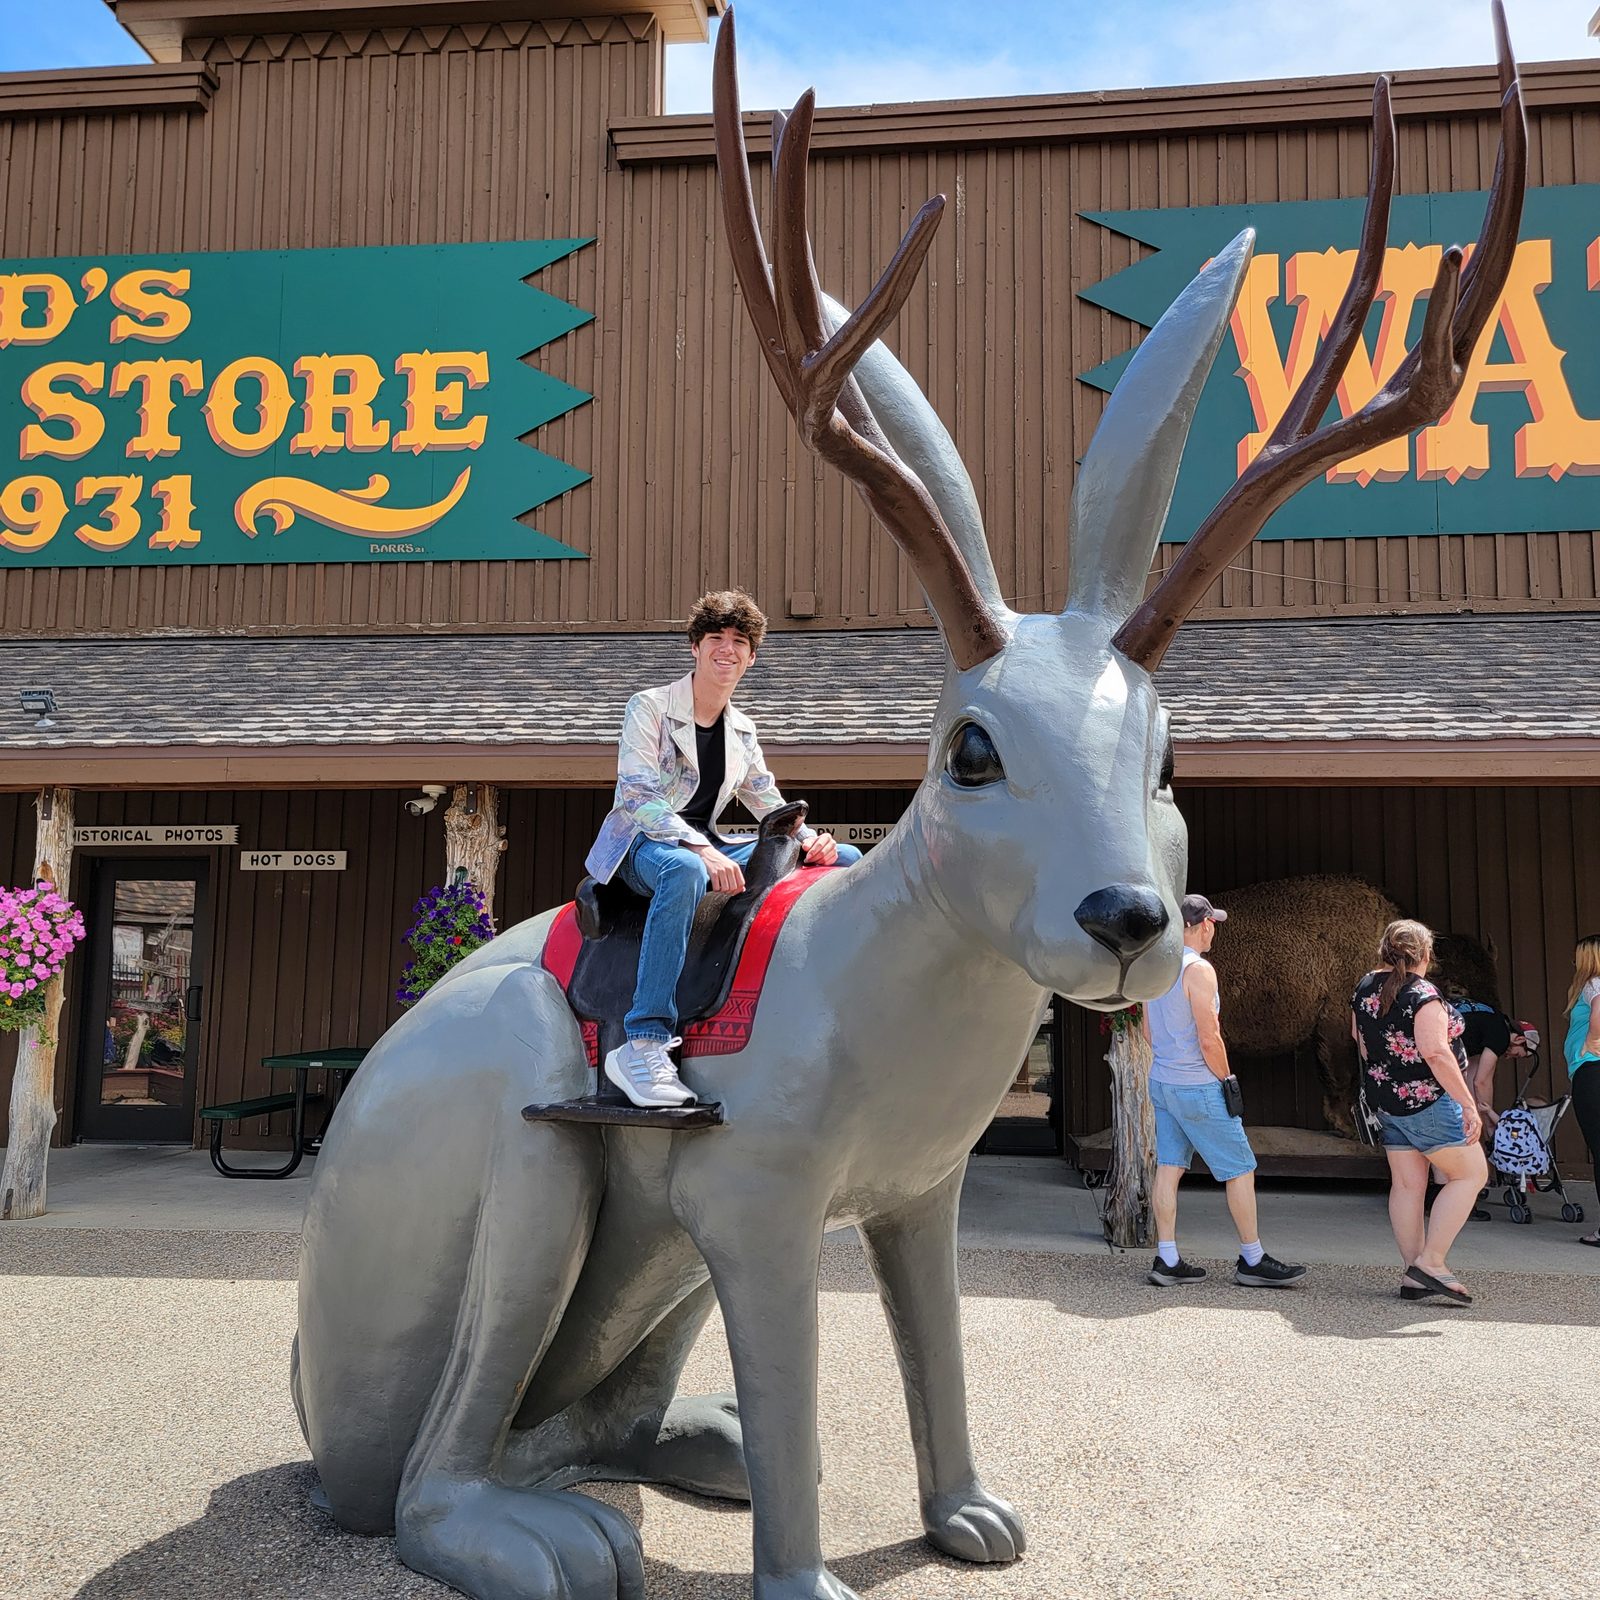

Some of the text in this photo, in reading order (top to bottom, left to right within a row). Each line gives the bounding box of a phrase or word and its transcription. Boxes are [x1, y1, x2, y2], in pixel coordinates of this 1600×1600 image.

[0, 267, 192, 349] D'S
[1200, 236, 1600, 488] WA
[19, 348, 490, 461] STORE
[0, 473, 202, 553] 931
[165, 829, 223, 841] PHOTOS
[250, 854, 336, 866] HOT DOGS
